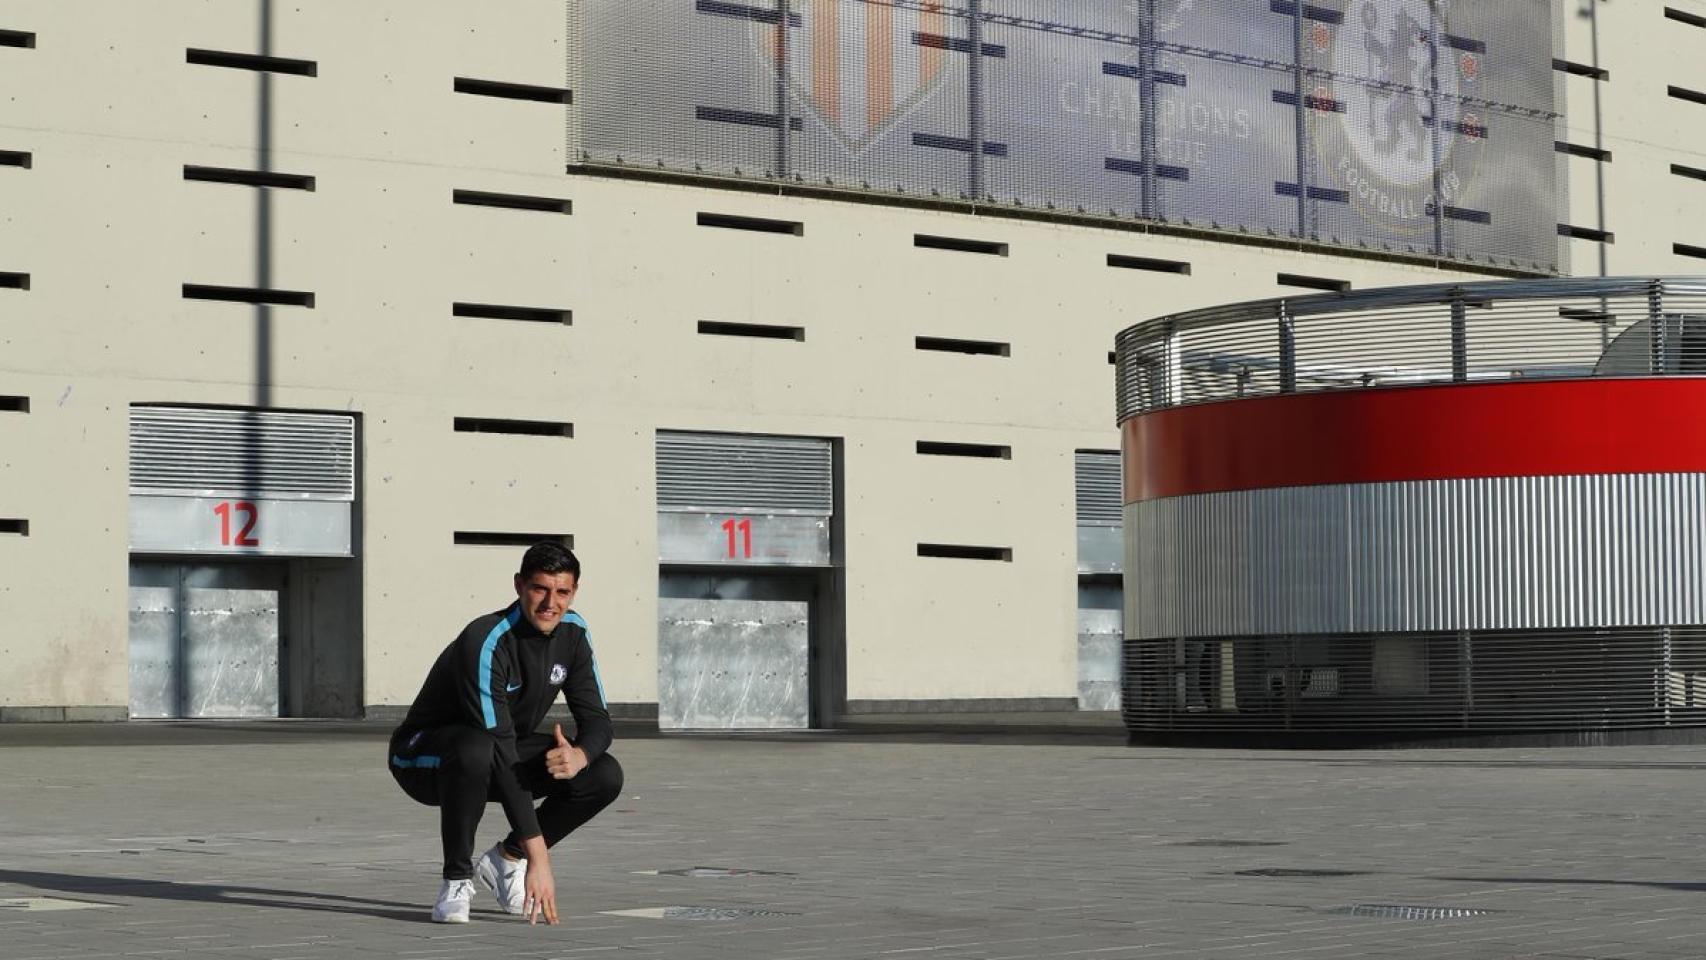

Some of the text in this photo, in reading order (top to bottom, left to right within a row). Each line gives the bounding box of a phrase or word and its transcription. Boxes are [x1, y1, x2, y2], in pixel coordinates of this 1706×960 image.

[1109, 129, 1207, 164] LEGUE
[1337, 155, 1461, 219] FOOTBALL CUB
[213, 500, 259, 547] 12
[721, 517, 752, 559] 11
